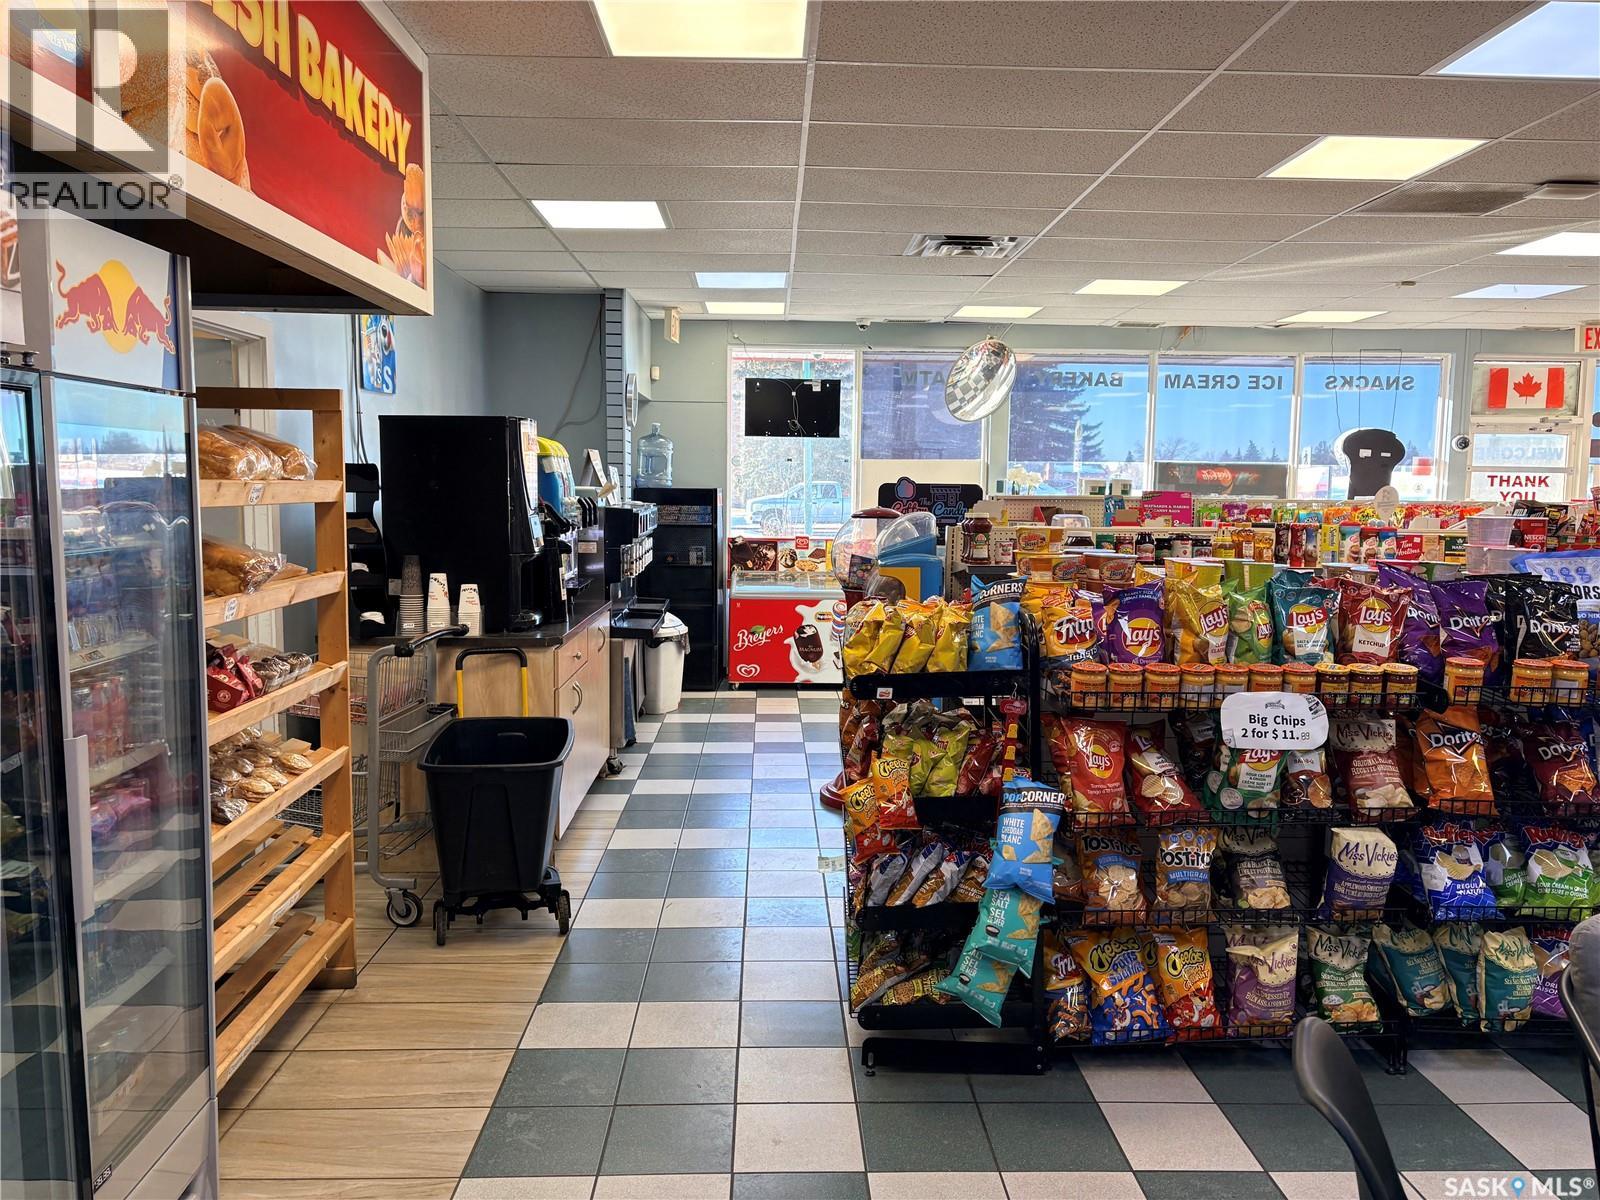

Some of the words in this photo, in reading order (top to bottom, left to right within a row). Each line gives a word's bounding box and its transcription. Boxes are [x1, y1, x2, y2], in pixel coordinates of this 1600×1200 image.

[297, 13, 412, 176] BAKERY
[1487, 475, 1550, 487] THANK
[931, 501, 967, 520] Candy
[1293, 609, 1324, 629] Lay's
[1360, 606, 1392, 626] Lay's
[734, 624, 783, 651] Breyers
[1249, 714, 1268, 727] Big
[1274, 715, 1306, 728] Chips
[1241, 728, 1248, 738] 2
[1251, 728, 1269, 739] for
[1003, 817, 1024, 828] WHITE
[1338, 842, 1365, 866] Miss
[1366, 843, 1398, 867] Vickie's
[991, 897, 1009, 909] SALT
[990, 907, 1006, 920] SEL
[1314, 934, 1339, 957] Miss
[963, 956, 978, 968] SEL
[1263, 952, 1296, 974] Vickie's
